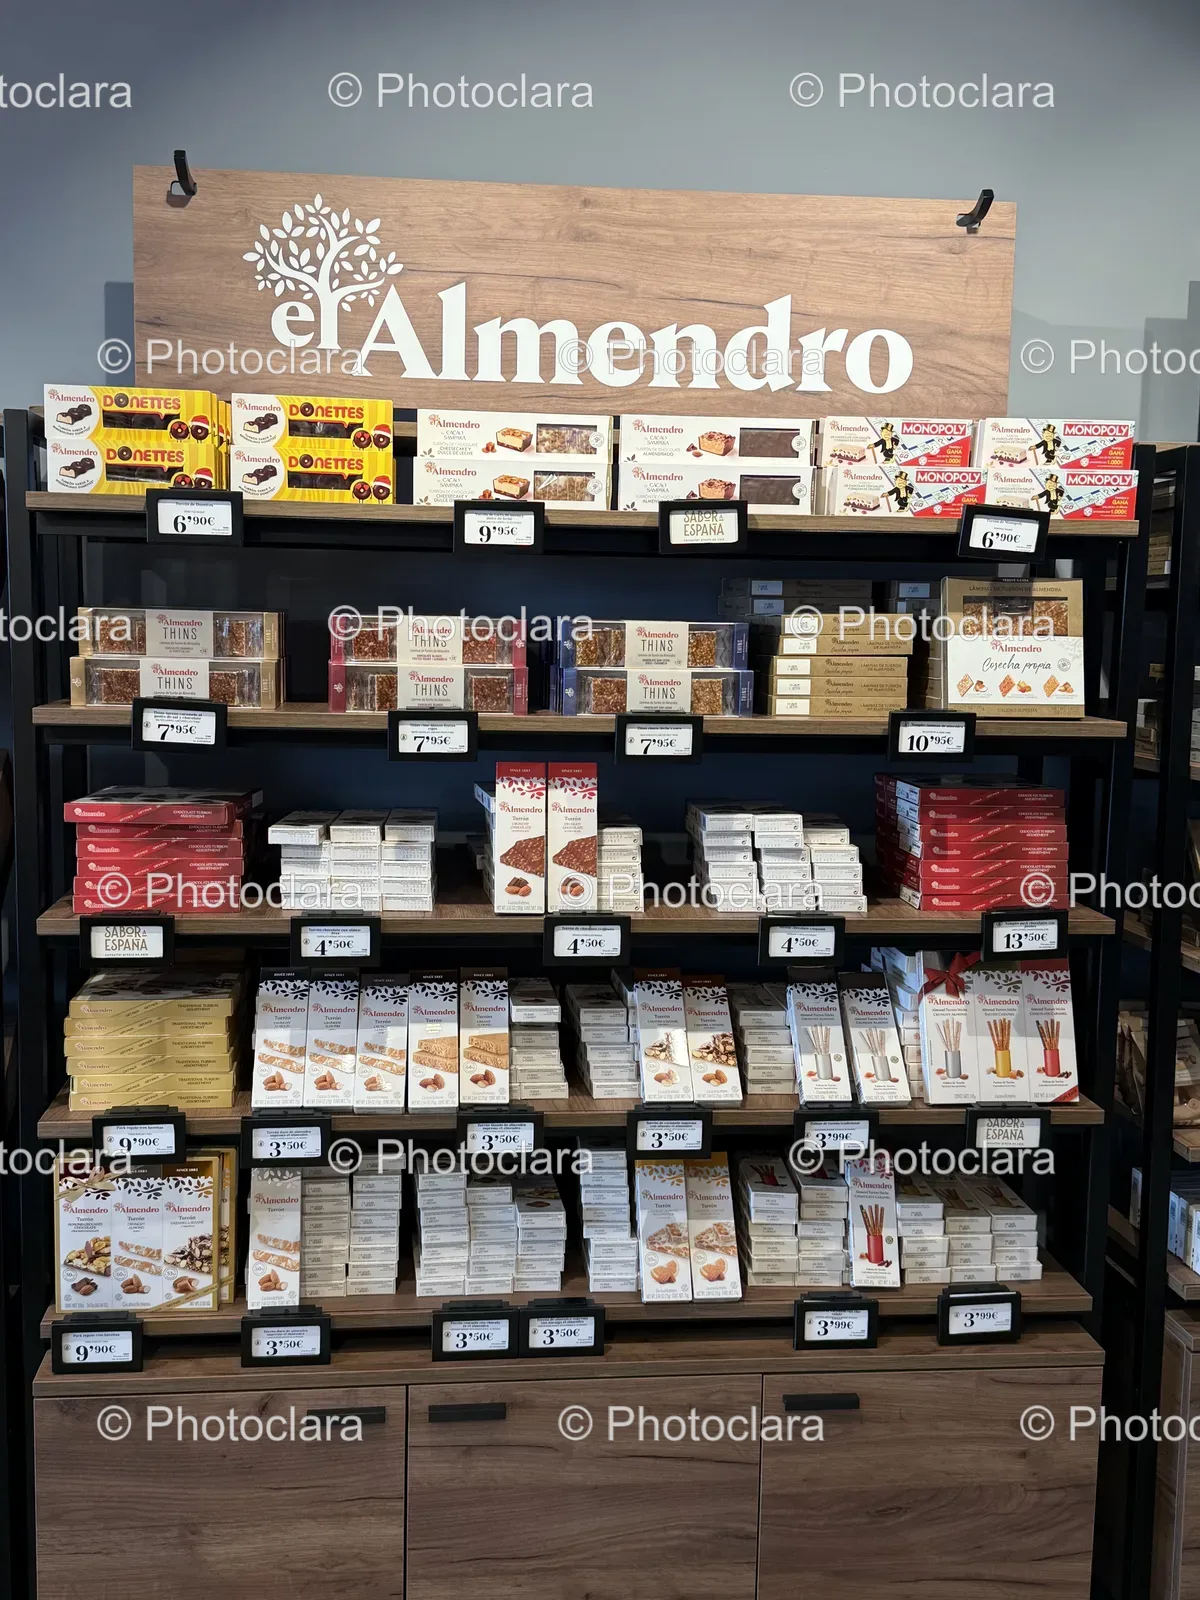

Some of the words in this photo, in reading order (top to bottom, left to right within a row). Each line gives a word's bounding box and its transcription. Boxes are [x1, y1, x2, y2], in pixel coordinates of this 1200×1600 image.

[352, 281, 914, 395] Almendro
[55, 394, 95, 403] Almendro
[103, 392, 180, 410] DONETTES
[242, 402, 282, 412] Almendro
[289, 402, 364, 420] DONETTES
[435, 419, 480, 430] Almendro
[640, 424, 684, 434] Almendro
[903, 424, 966, 435] MONOPOLY
[1065, 425, 1128, 436] MONOPOLY
[58, 447, 98, 456] Almendro
[106, 446, 184, 463] DONETTES
[241, 454, 280, 464] Almendro
[288, 454, 364, 470] DONETTES
[432, 467, 477, 477] Almendro
[640, 472, 684, 482] Almendro
[917, 472, 980, 483] MONOPOLY
[1068, 474, 1132, 485] MONOPOLY
[684, 510, 718, 523] SABOR
[684, 523, 724, 536] ESPAÑA
[164, 619, 203, 627] Almendro
[163, 627, 197, 640] THINS
[413, 634, 447, 648] THINS
[641, 639, 674, 652] THINS
[998, 644, 1042, 653] Almendro
[982, 654, 1020, 672] Cosecha
[1021, 661, 1052, 674] propia
[158, 668, 198, 676] Almendro
[157, 677, 193, 690] THINS
[417, 675, 454, 683] Almendro
[644, 678, 681, 686] Almendro
[414, 683, 448, 696] THINS
[643, 687, 675, 699] THINS
[104, 926, 141, 938] SABOR
[104, 938, 148, 951] ESPAÑA
[934, 998, 970, 1006] Almendro
[987, 1118, 1019, 1128] SABOR
[986, 1129, 1024, 1140] ESPAÑA
[858, 1182, 892, 1190] Almendro
[259, 1196, 299, 1204] Almendro
[69, 1206, 108, 1214] Almendro
[172, 1205, 210, 1213] Almendro
